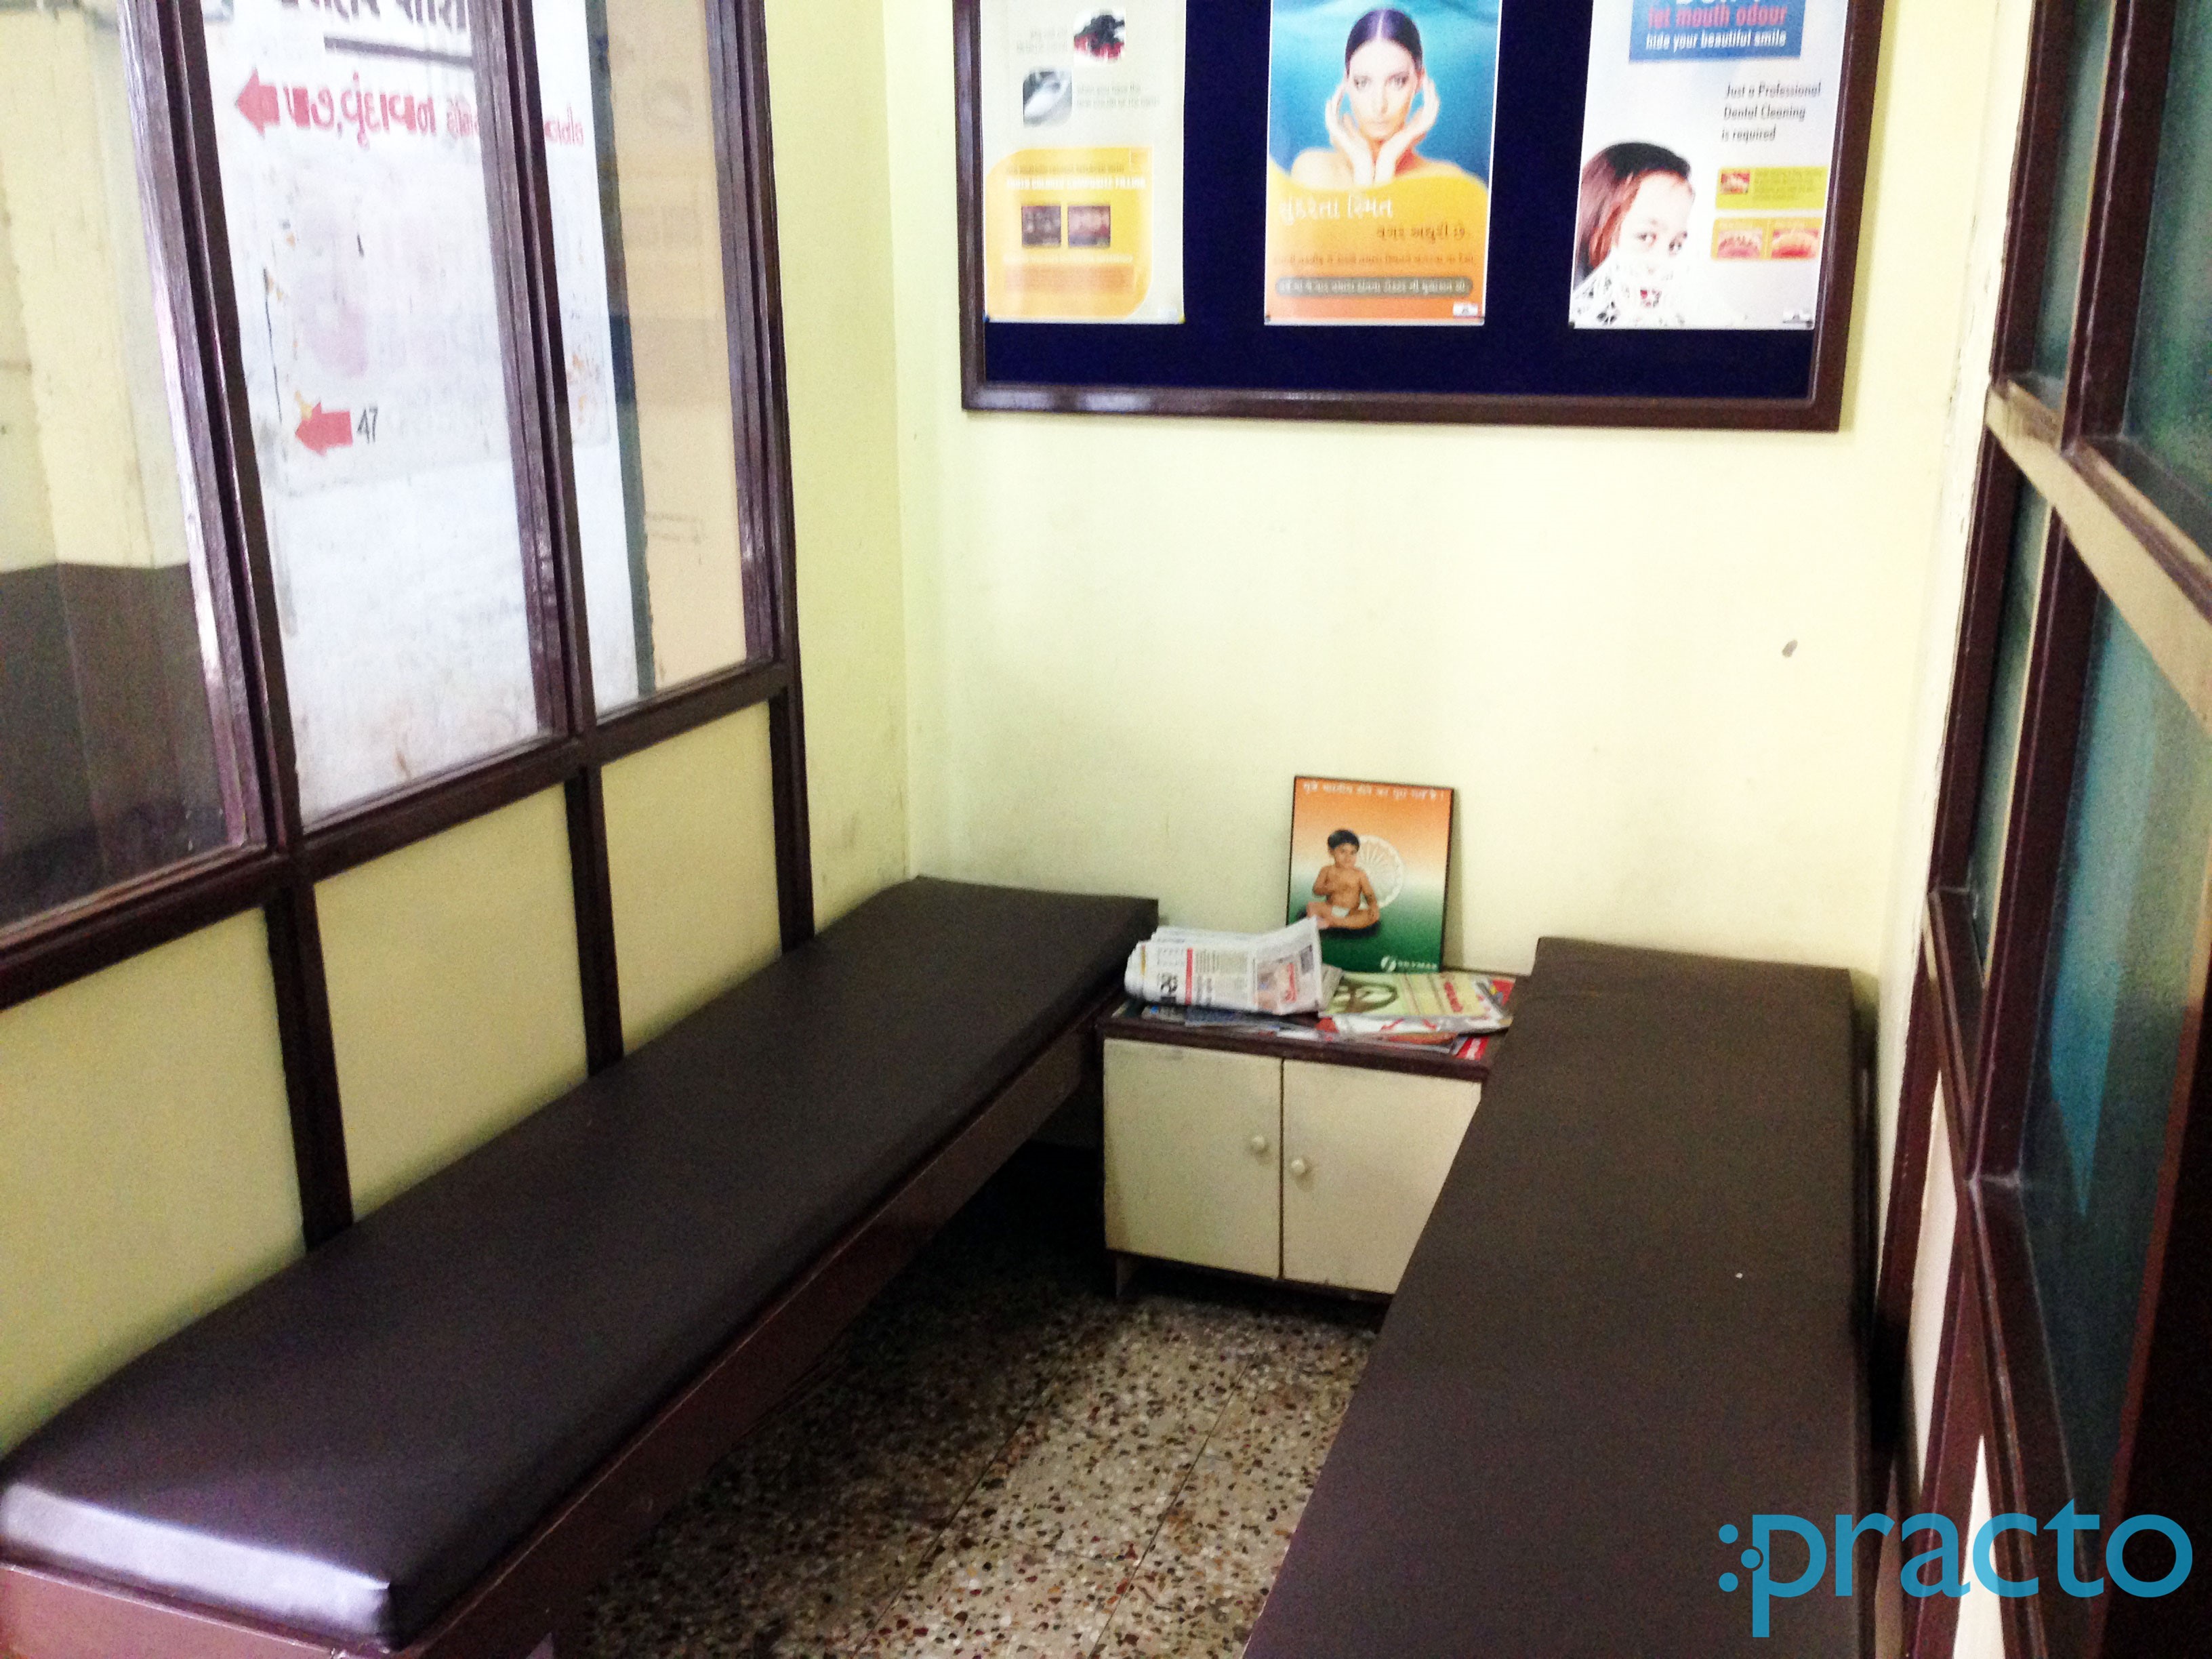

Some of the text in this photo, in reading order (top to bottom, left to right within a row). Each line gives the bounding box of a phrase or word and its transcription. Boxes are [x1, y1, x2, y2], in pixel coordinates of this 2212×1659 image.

[1676, 4, 1730, 28] mouth
[1736, 3, 1788, 26] odour
[1646, 29, 1787, 54] hide your beautiful smile
[1725, 83, 1745, 99] Just
[1759, 80, 1822, 98] Professional
[1724, 104, 1806, 122] Dental Cleaning
[1721, 123, 1777, 143] is required
